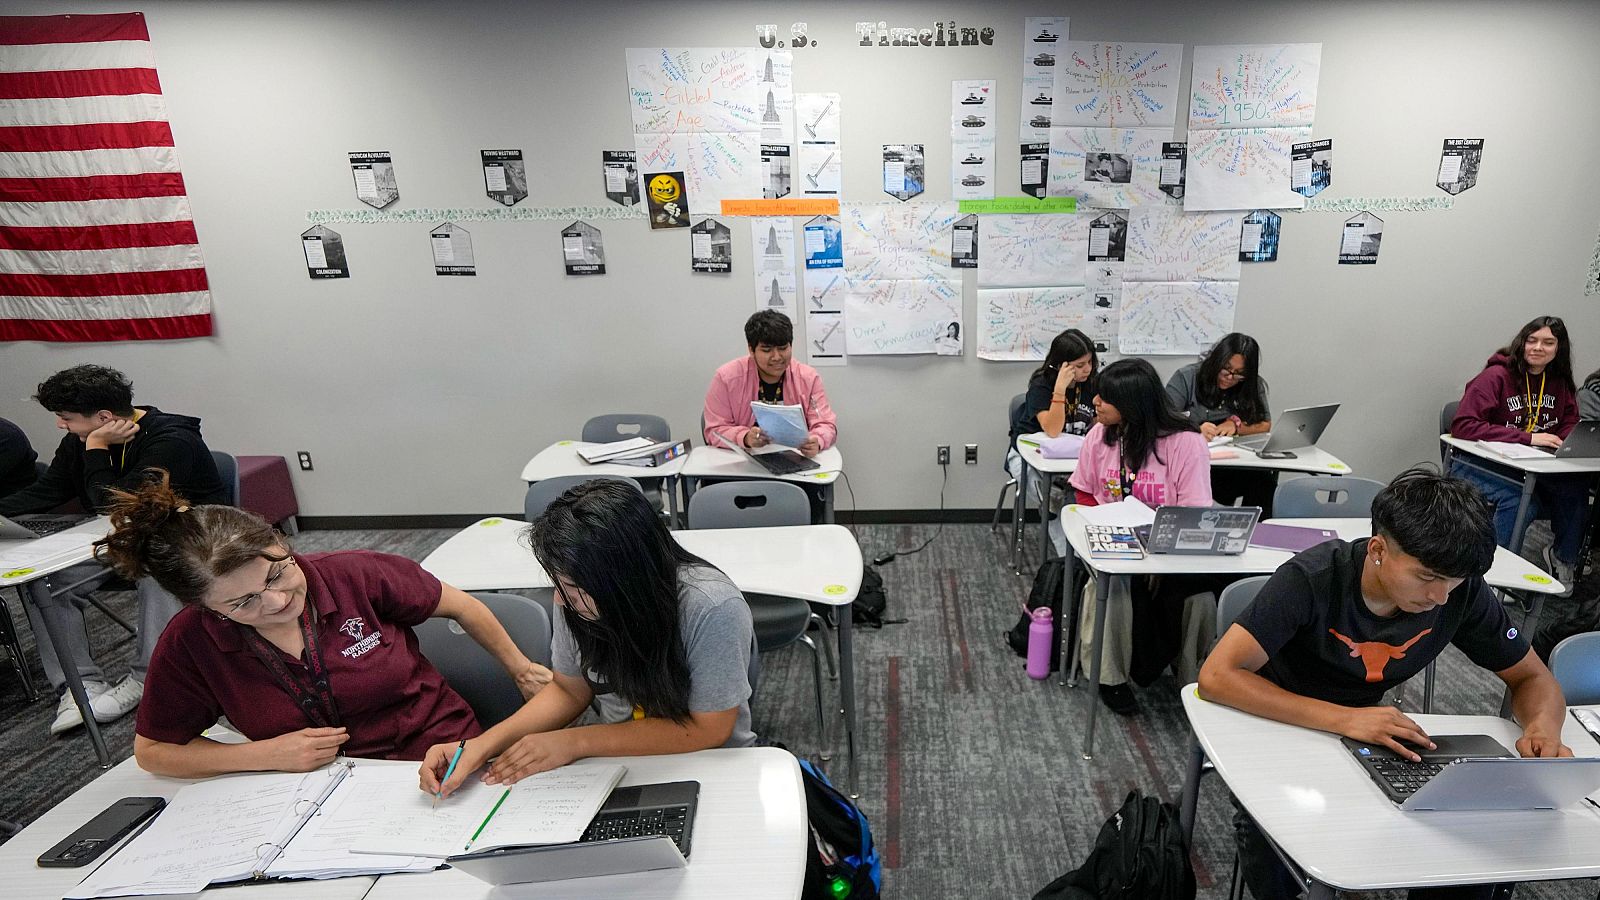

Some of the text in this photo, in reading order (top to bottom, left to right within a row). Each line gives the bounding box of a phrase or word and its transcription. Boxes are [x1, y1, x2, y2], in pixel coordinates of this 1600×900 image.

[756, 20, 995, 48] U.S. Timeline
[1135, 62, 1168, 81] Red Scare
[664, 86, 711, 105] Gilded
[1218, 100, 1271, 125] 1950s
[677, 110, 705, 138] Age
[1230, 127, 1249, 137] Cold
[1153, 250, 1190, 266] World
[1166, 270, 1191, 283] War
[853, 320, 887, 339] Direct
[341, 630, 383, 658] NORTHBROOK
[351, 639, 381, 659] RAIDERS
